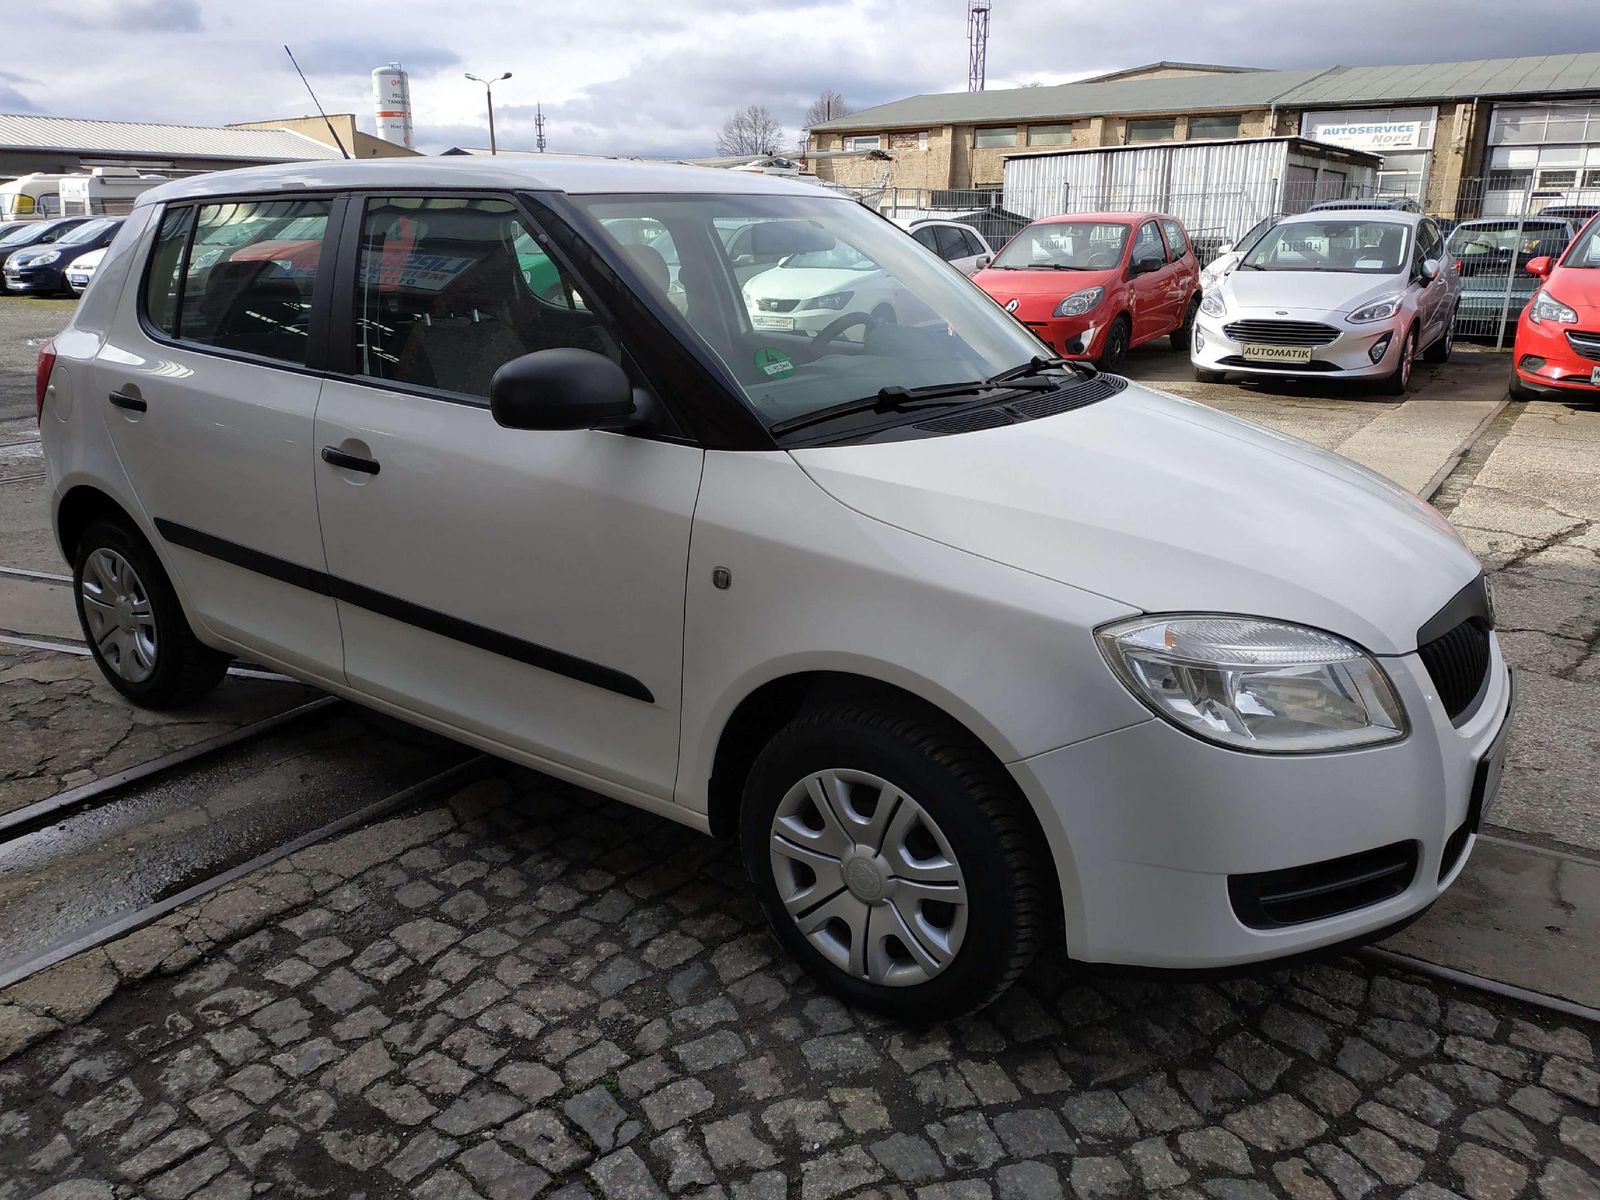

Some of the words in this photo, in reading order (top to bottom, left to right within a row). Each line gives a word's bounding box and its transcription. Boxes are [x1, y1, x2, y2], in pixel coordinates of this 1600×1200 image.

[1323, 124, 1414, 136] AUTOSERVICE
[1371, 133, 1413, 143] Nord
[1245, 347, 1310, 358] AUTOMATIK
